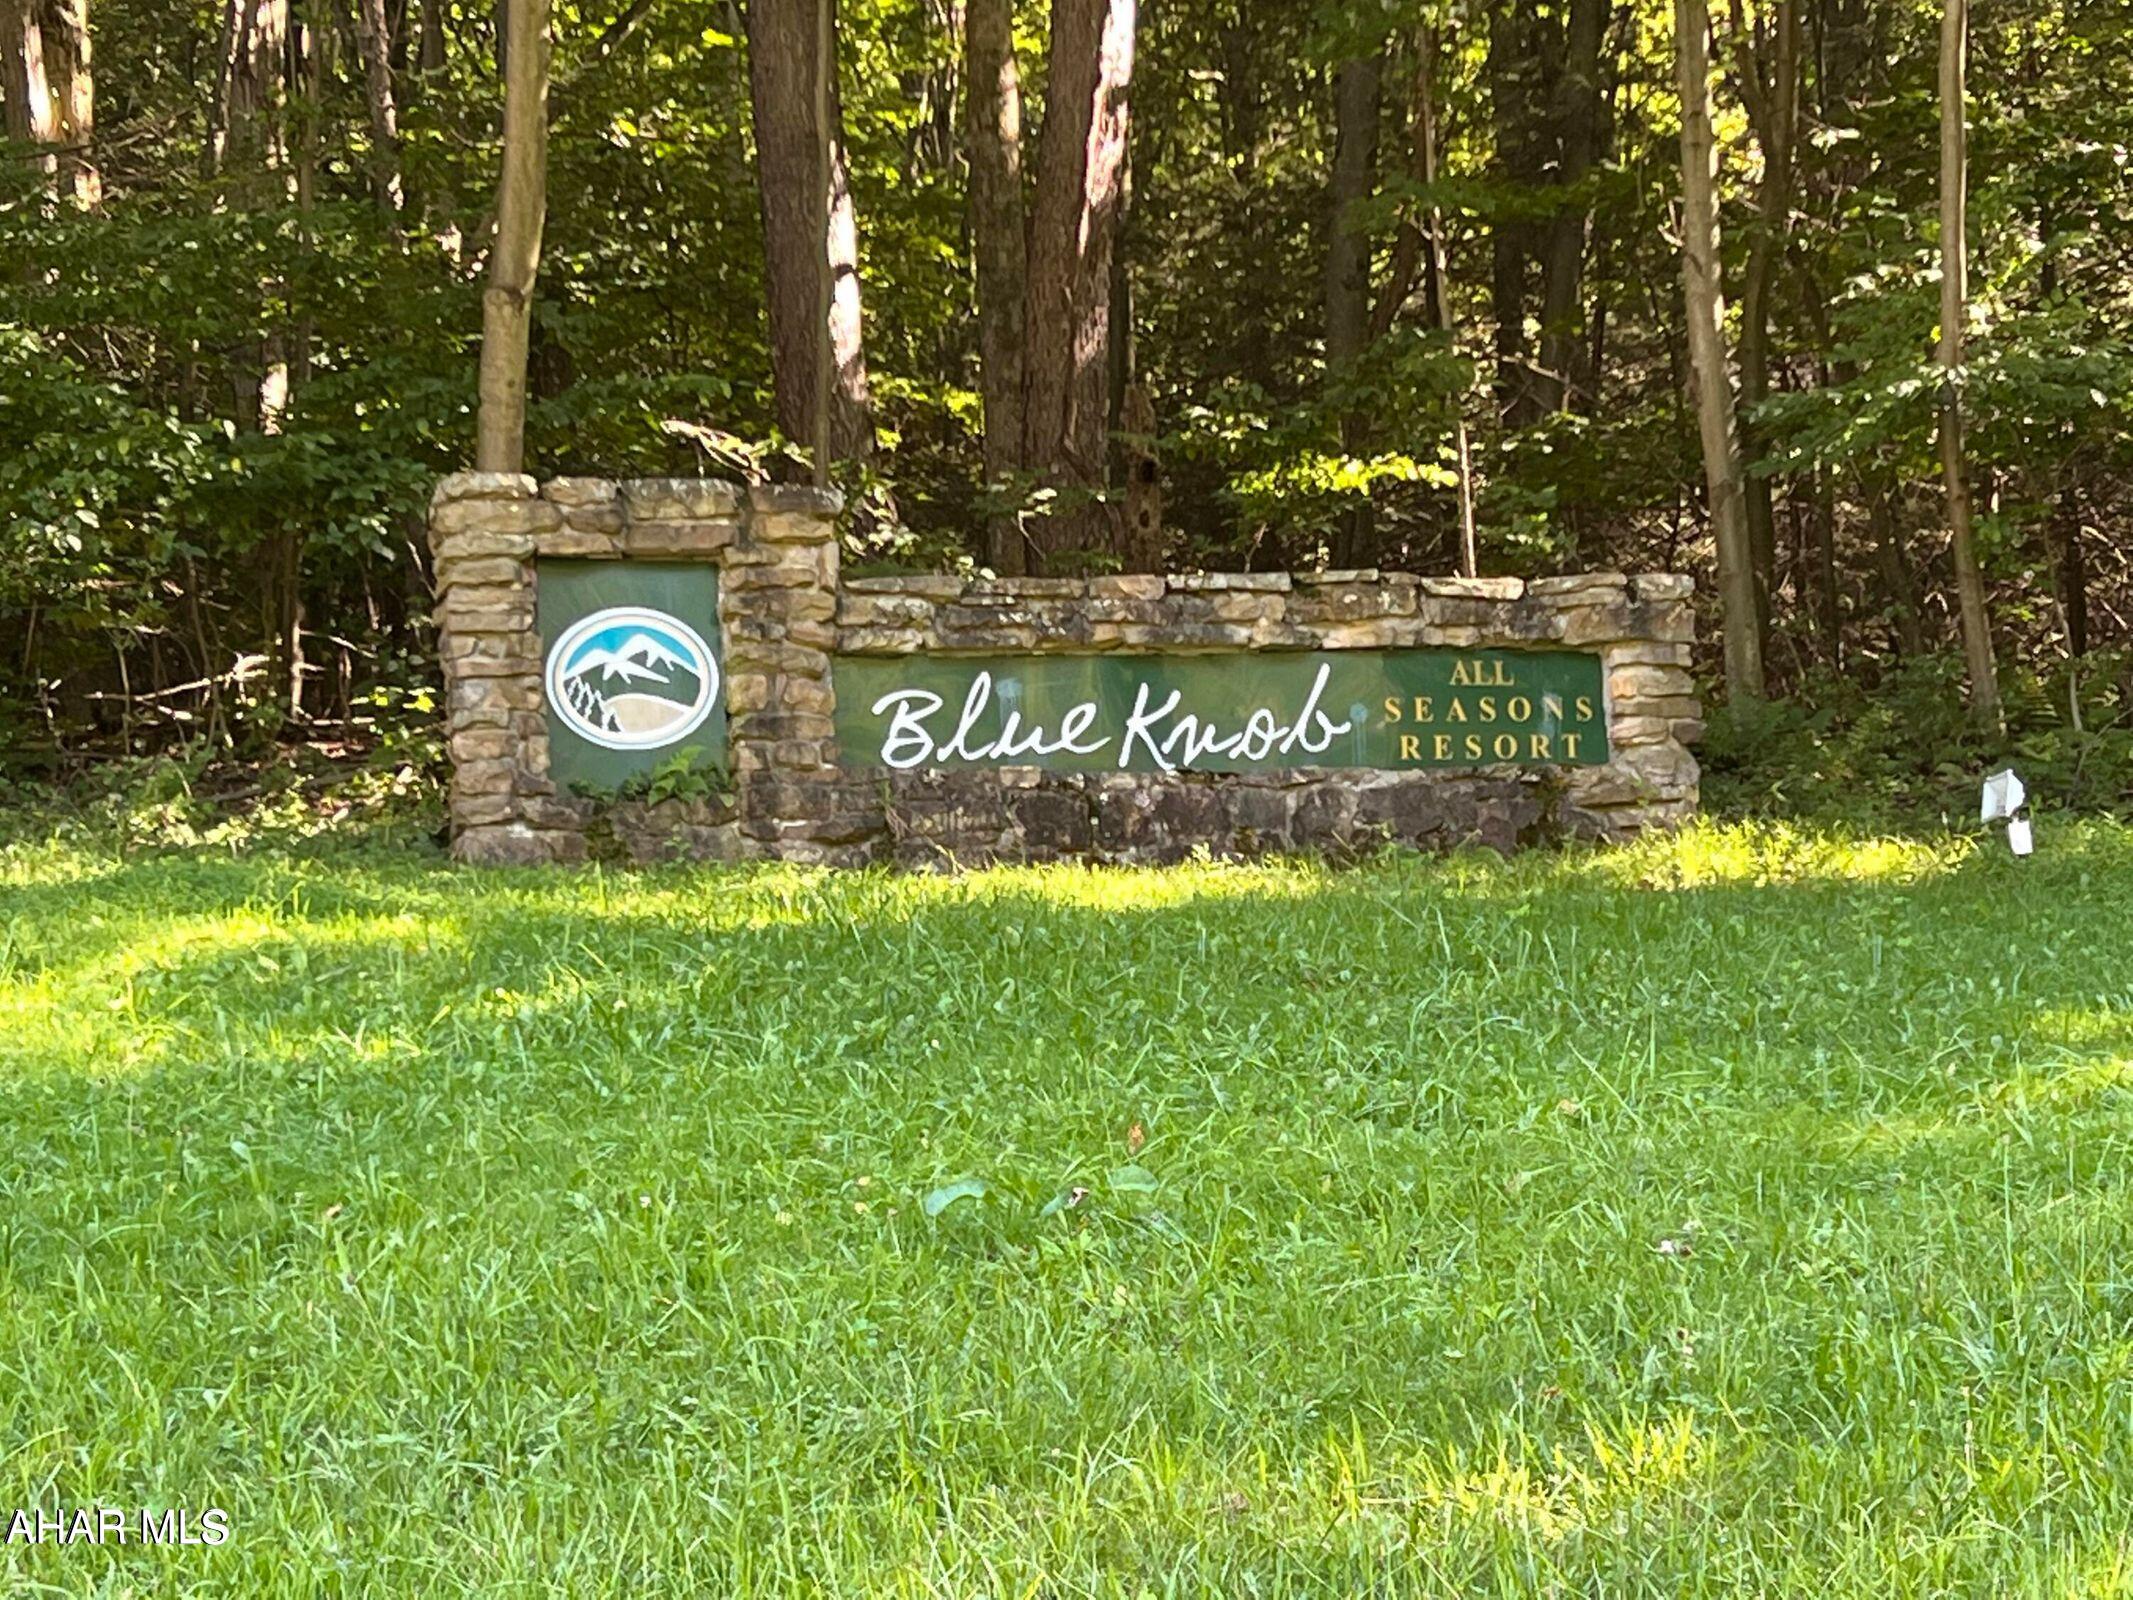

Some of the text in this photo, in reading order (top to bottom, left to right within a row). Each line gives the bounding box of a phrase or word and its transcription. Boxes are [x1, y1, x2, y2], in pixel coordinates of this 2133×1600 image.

[1449, 659, 1515, 687] ALL
[871, 662, 1352, 771] Blue Knob
[1384, 696, 1594, 723] SEASONS
[1400, 733, 1582, 761] RESORT
